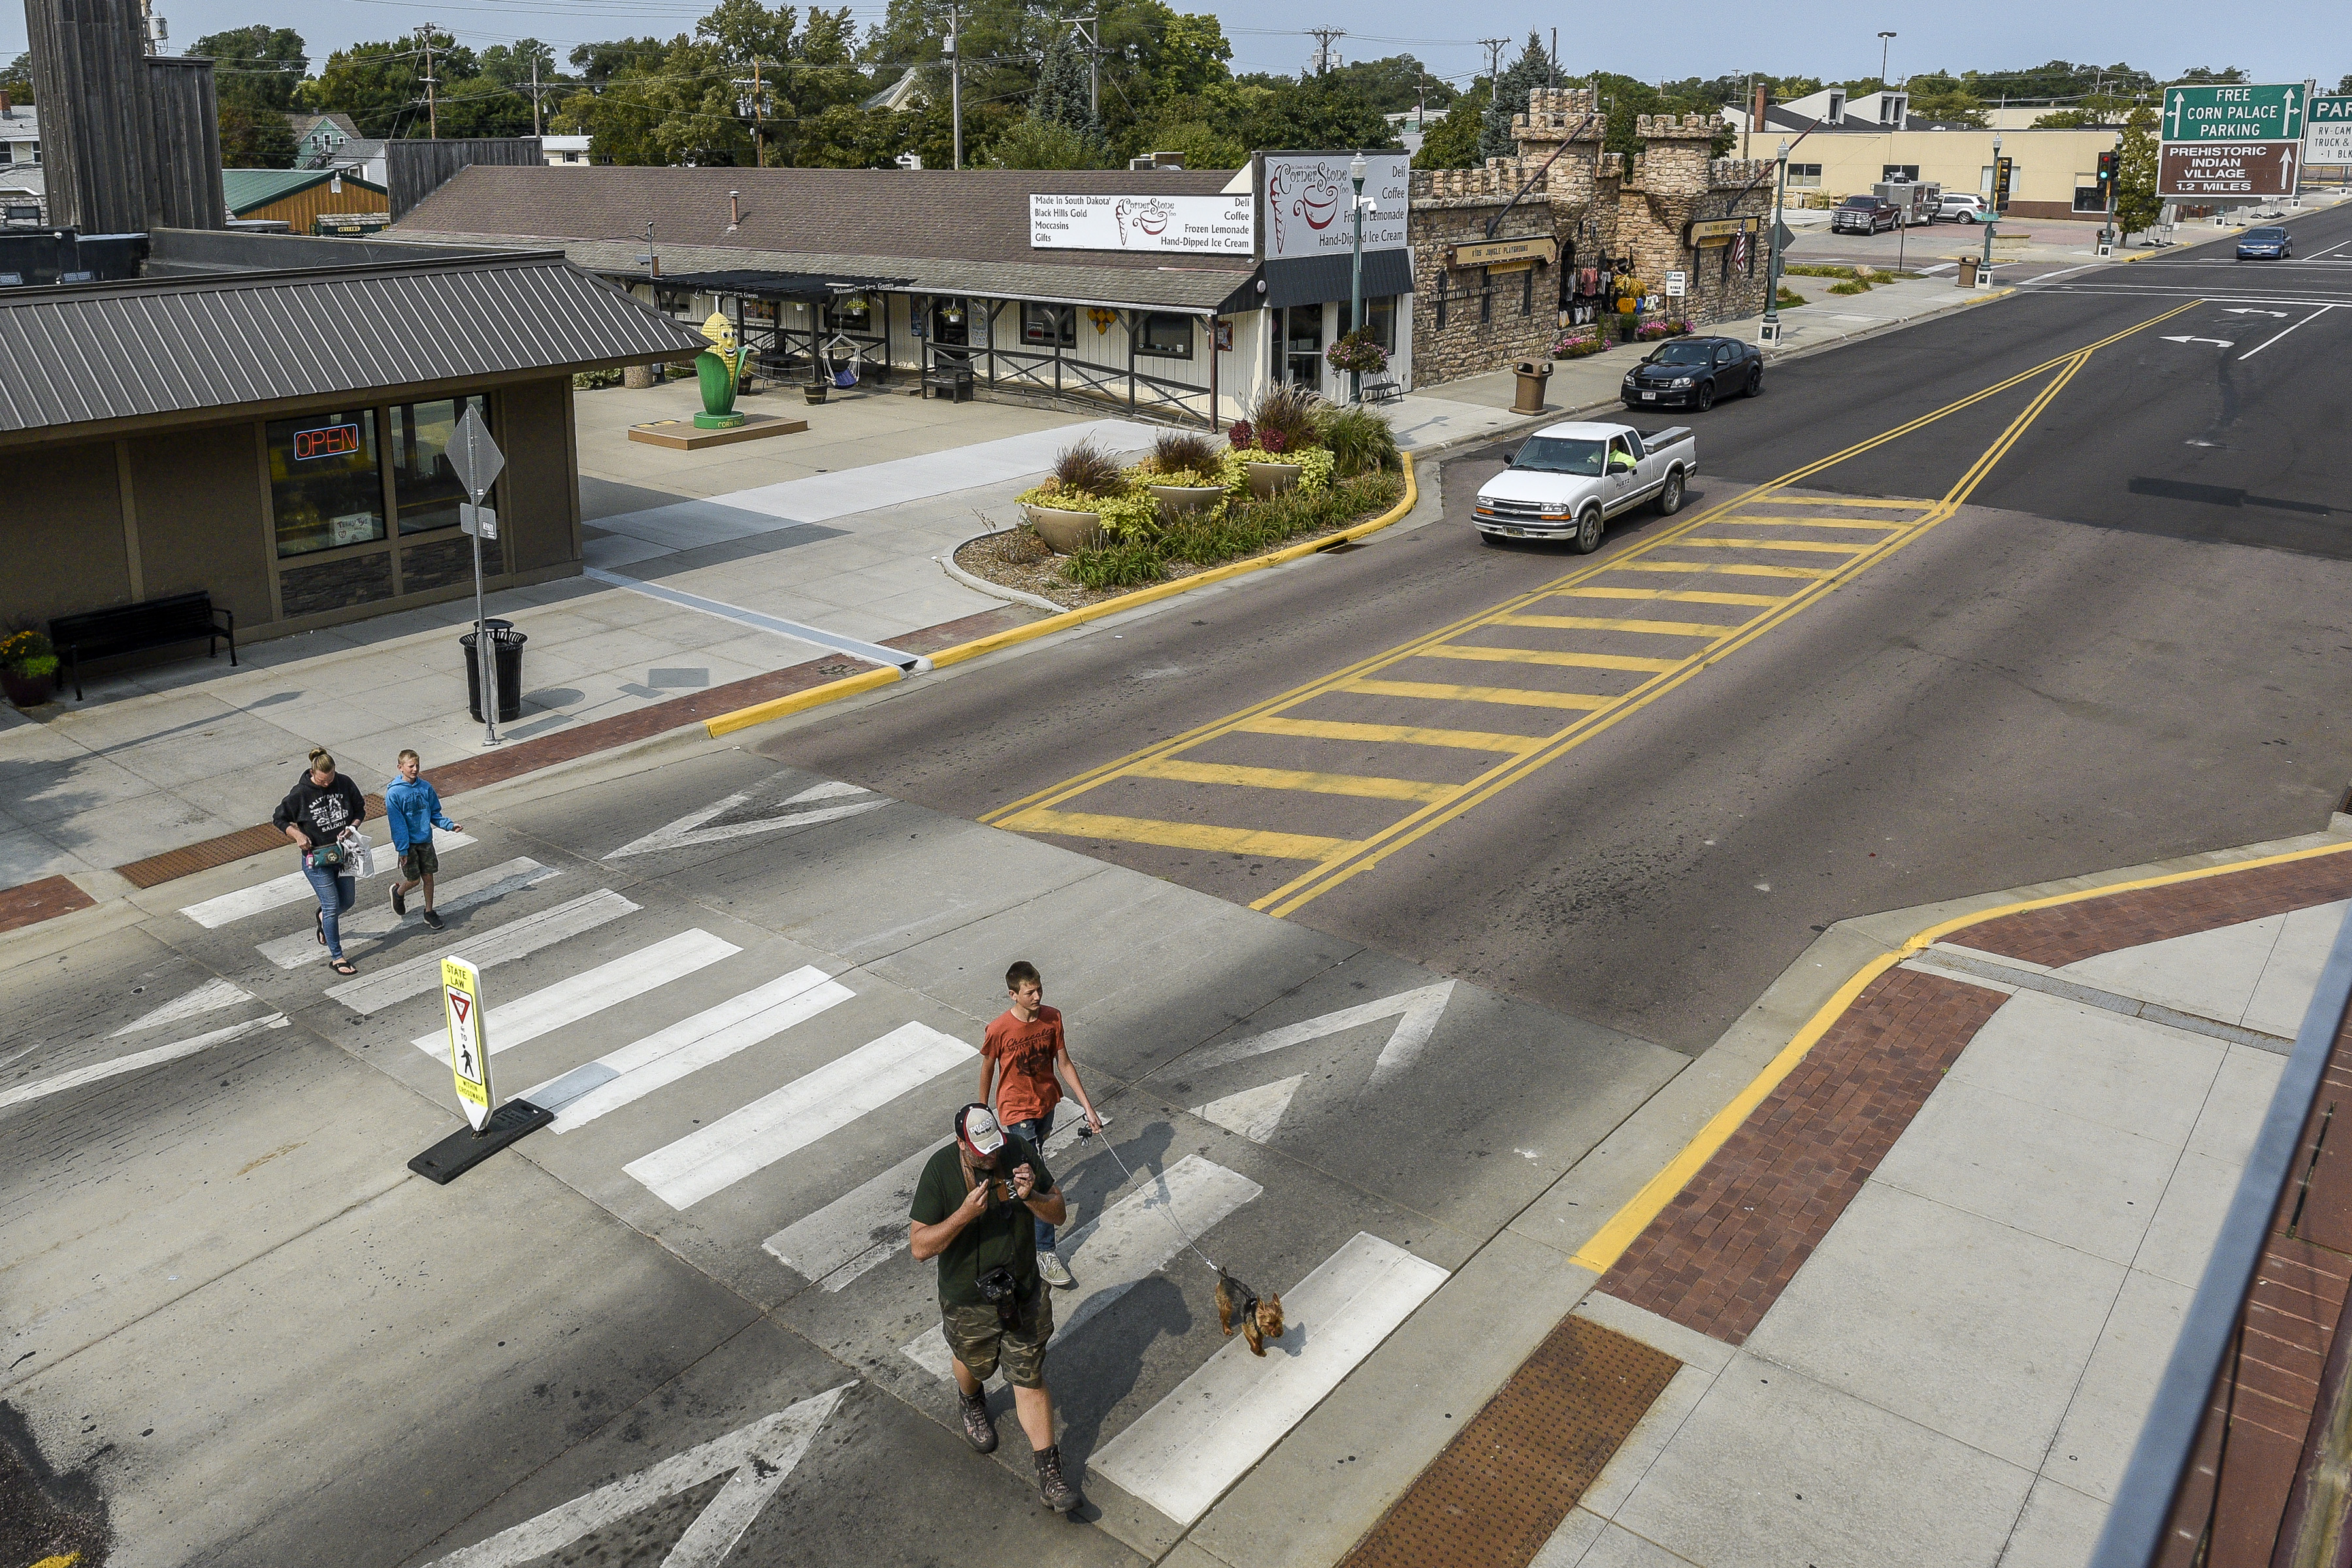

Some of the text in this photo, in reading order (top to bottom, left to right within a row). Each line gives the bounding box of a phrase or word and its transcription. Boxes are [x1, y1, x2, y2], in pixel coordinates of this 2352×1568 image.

[2216, 88, 2251, 102] FREE
[2187, 105, 2278, 120] CORN PALACE
[2200, 123, 2260, 137] PARKING
[2315, 138, 2349, 147] TRUCK &
[2169, 146, 2267, 157] PREHISTORIC
[2338, 150, 2352, 158] BLK
[2191, 158, 2241, 167] INDIAN
[1392, 165, 1406, 178] Deli
[2184, 169, 2246, 178] VILLAGE
[1339, 183, 1349, 194] Too
[1382, 187, 1405, 199] Coffee
[1056, 196, 1062, 204] In
[1065, 196, 1084, 204] South
[1235, 198, 1249, 207] Deli
[1035, 208, 1087, 218] Black Hills Gold
[1224, 211, 1249, 220] Coffee
[1343, 210, 1367, 223] Fron
[1035, 221, 1069, 229] Moccasins
[1184, 223, 1249, 234] Frozen Lemonade
[1035, 233, 1051, 242] Gifts
[1161, 236, 1249, 248] Hand-Dipped Ice Cream
[1319, 229, 1403, 247] Hand-Dipd Ice Cream
[1428, 293, 1441, 302] BIBLE
[297, 426, 355, 457] OPEN
[1616, 478, 1630, 489] PUETZ
[446, 964, 467, 980] STATE
[451, 975, 464, 988] LAW
[461, 1033, 467, 1041] TO
[1008, 1041, 1030, 1052] MOTOR
[463, 1080, 478, 1092] WITHIN
[459, 1085, 484, 1102] CROSSWALK
